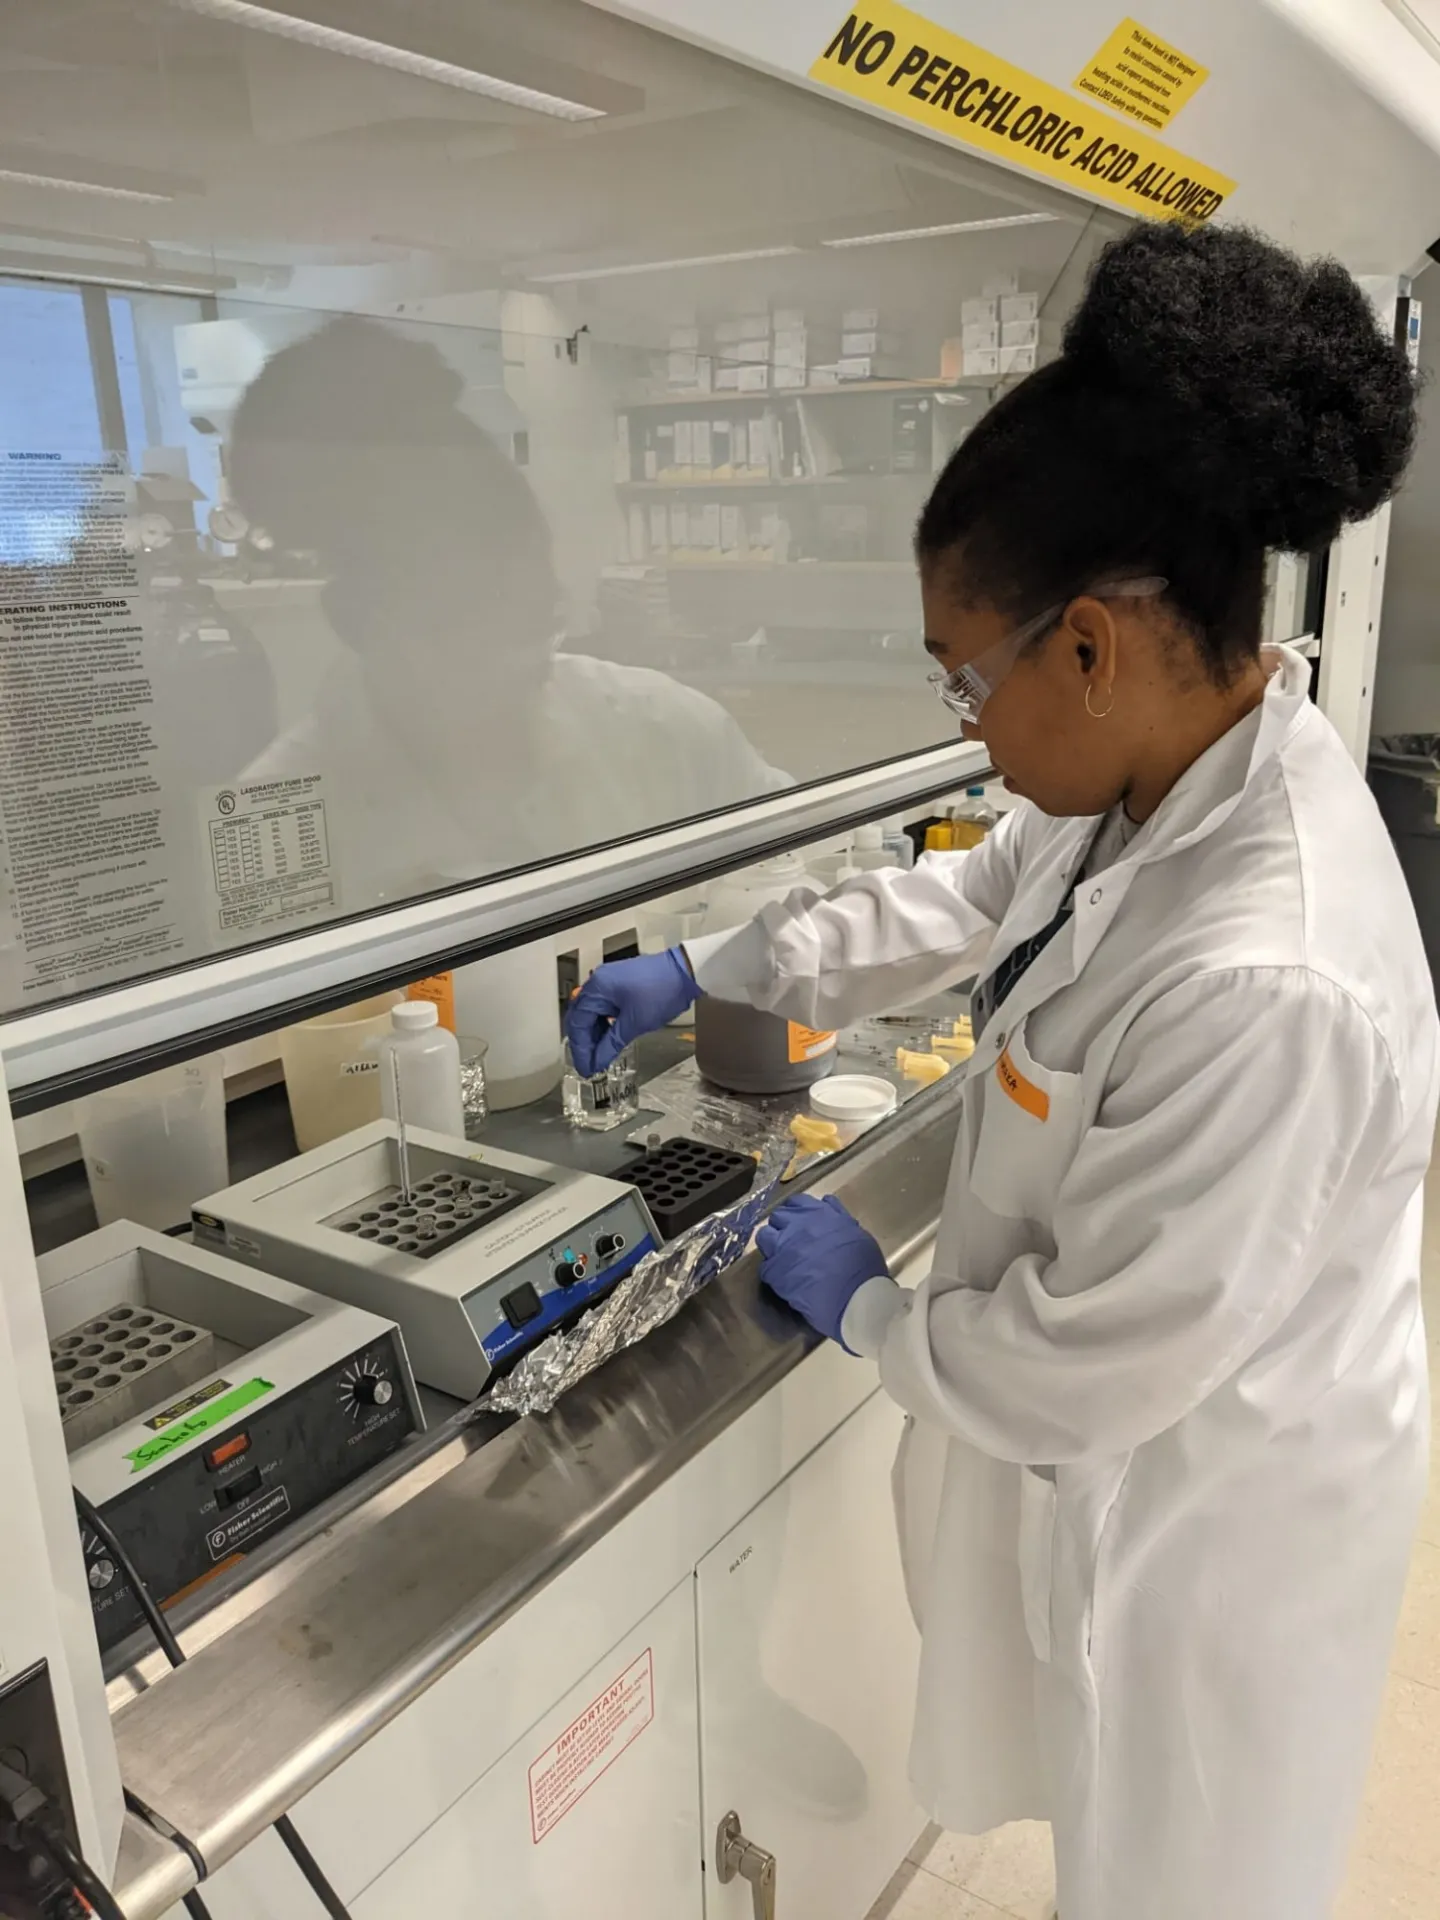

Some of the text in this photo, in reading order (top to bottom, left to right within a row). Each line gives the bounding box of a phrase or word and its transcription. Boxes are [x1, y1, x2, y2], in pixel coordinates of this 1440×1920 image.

[823, 14, 1224, 219] NO PERCHLORIC ACID ALLOWED
[8, 452, 61, 461] WARNING
[48, 599, 127, 612] INSTRUCTIONS
[240, 781, 282, 795] LABORATORY
[284, 778, 301, 786] FUME
[302, 774, 321, 783] HOOD
[347, 1407, 400, 1446] TEMPERATURE SET
[218, 1455, 246, 1476] HEATER
[199, 1500, 217, 1515] LOW
[236, 1497, 250, 1510] OFF
[227, 1495, 285, 1536] Fisher Scientific
[728, 1545, 753, 1574] WATER
[114, 1586, 130, 1601] SET
[556, 1678, 624, 1756] IMPORTANT
